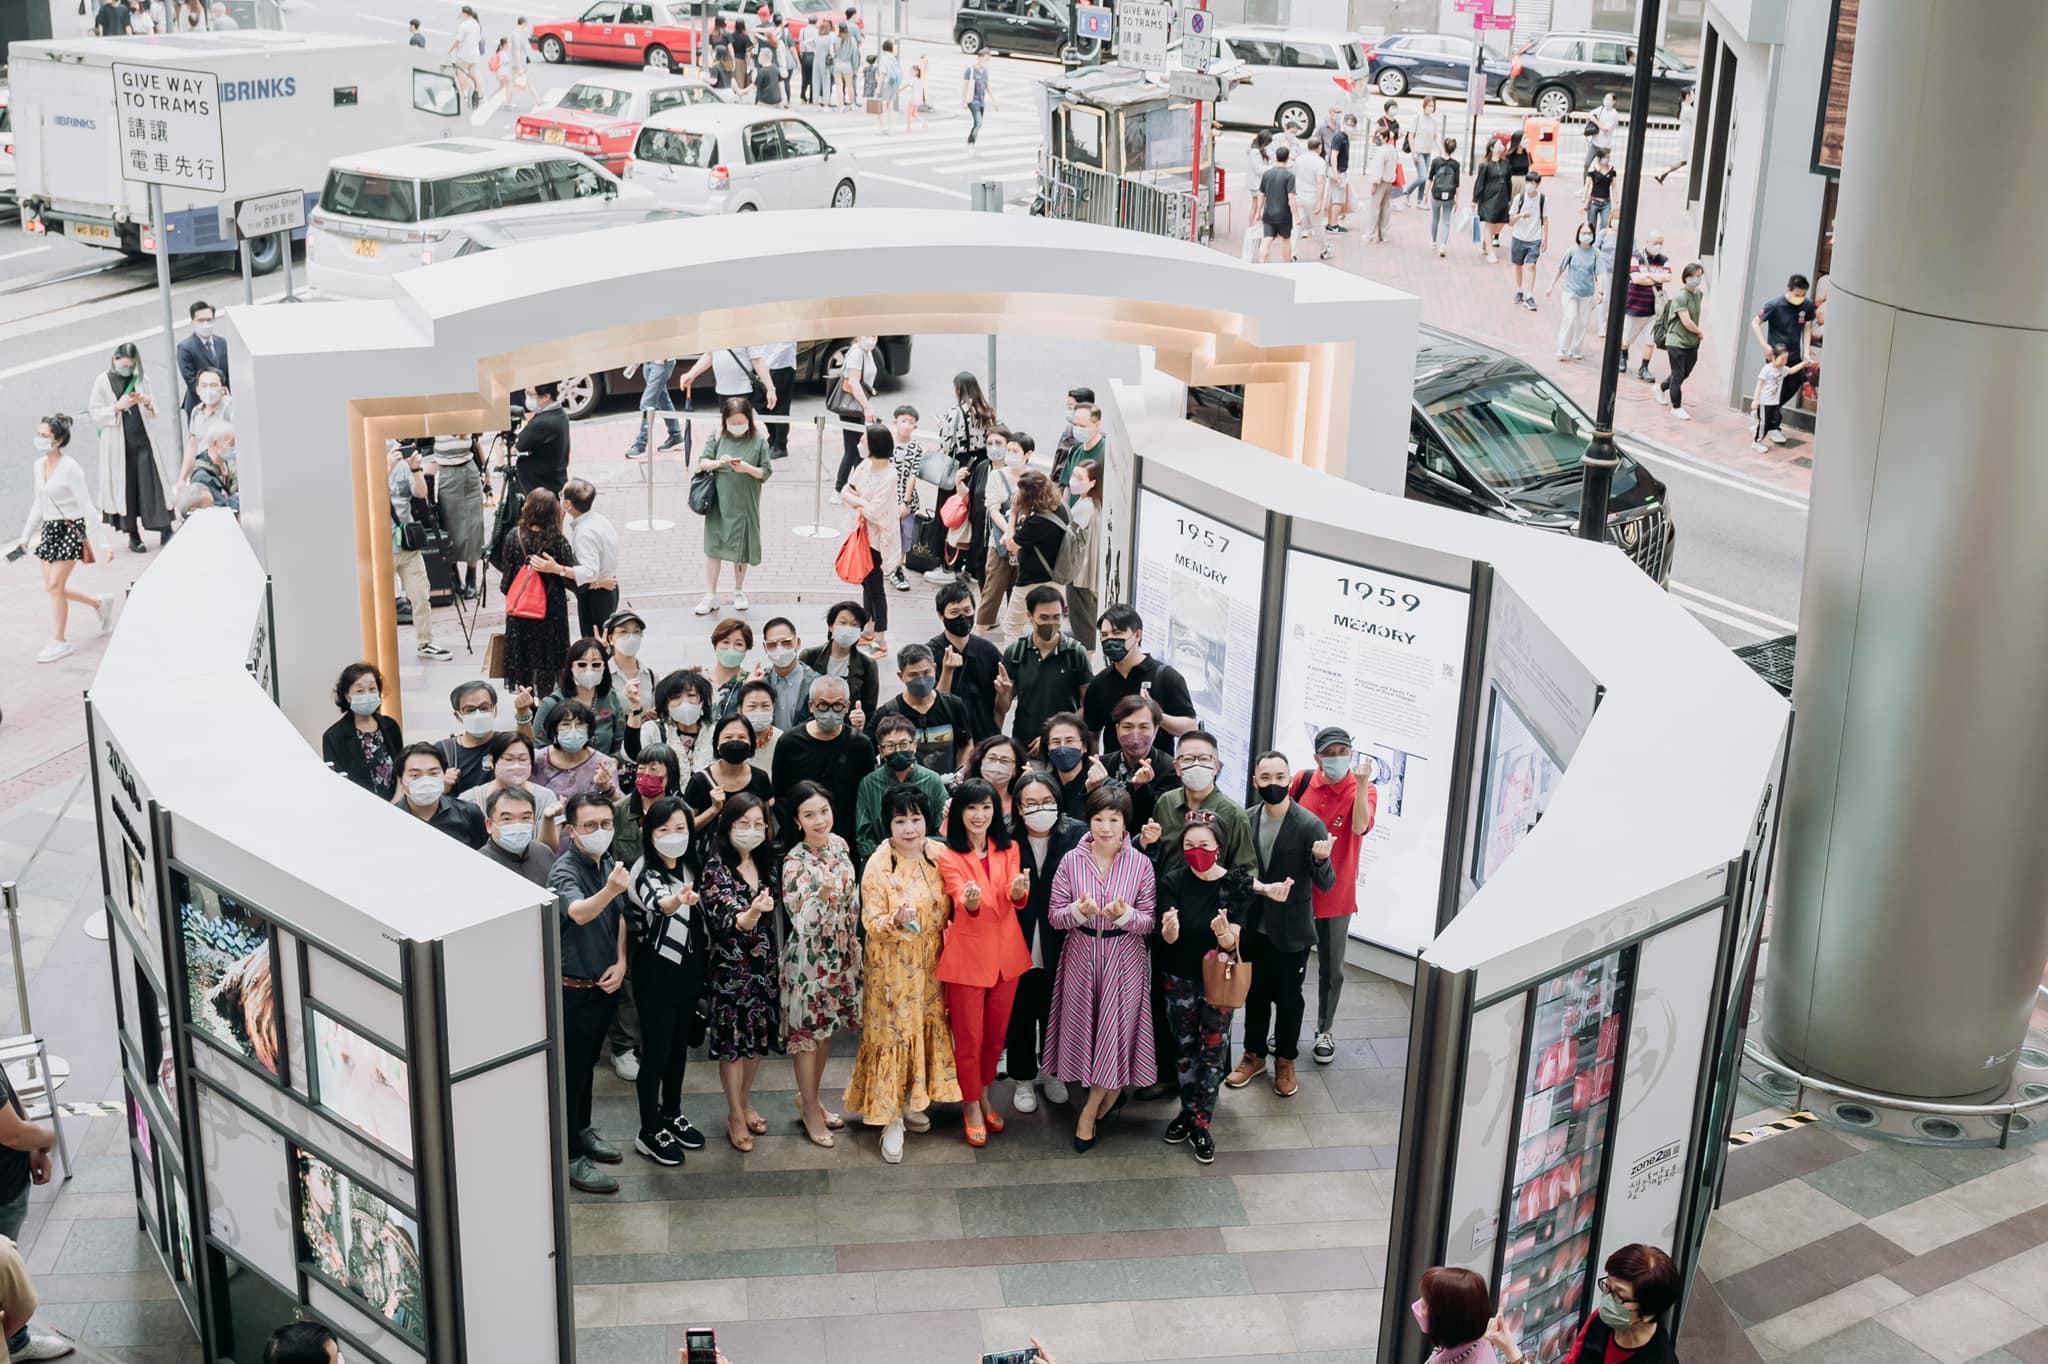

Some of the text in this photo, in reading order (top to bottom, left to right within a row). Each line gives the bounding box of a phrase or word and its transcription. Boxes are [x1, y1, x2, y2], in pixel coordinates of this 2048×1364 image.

[1123, 5, 1161, 18] GIVE WAY
[1123, 17, 1163, 30] TO TRAMS
[1200, 40, 1206, 51] 7
[1199, 58, 1208, 69] 12
[122, 72, 203, 95] GIVE WAY
[223, 77, 296, 103] BRINKS
[123, 91, 209, 116] TO TRAMS
[59, 116, 96, 130] BRINKS
[128, 116, 168, 143] 請讓
[130, 149, 216, 181] 電車先行
[1176, 519, 1230, 553] 1957
[1175, 553, 1228, 585] MEMORY
[1337, 578, 1421, 612] 1959
[1333, 614, 1416, 645] MEMORY
